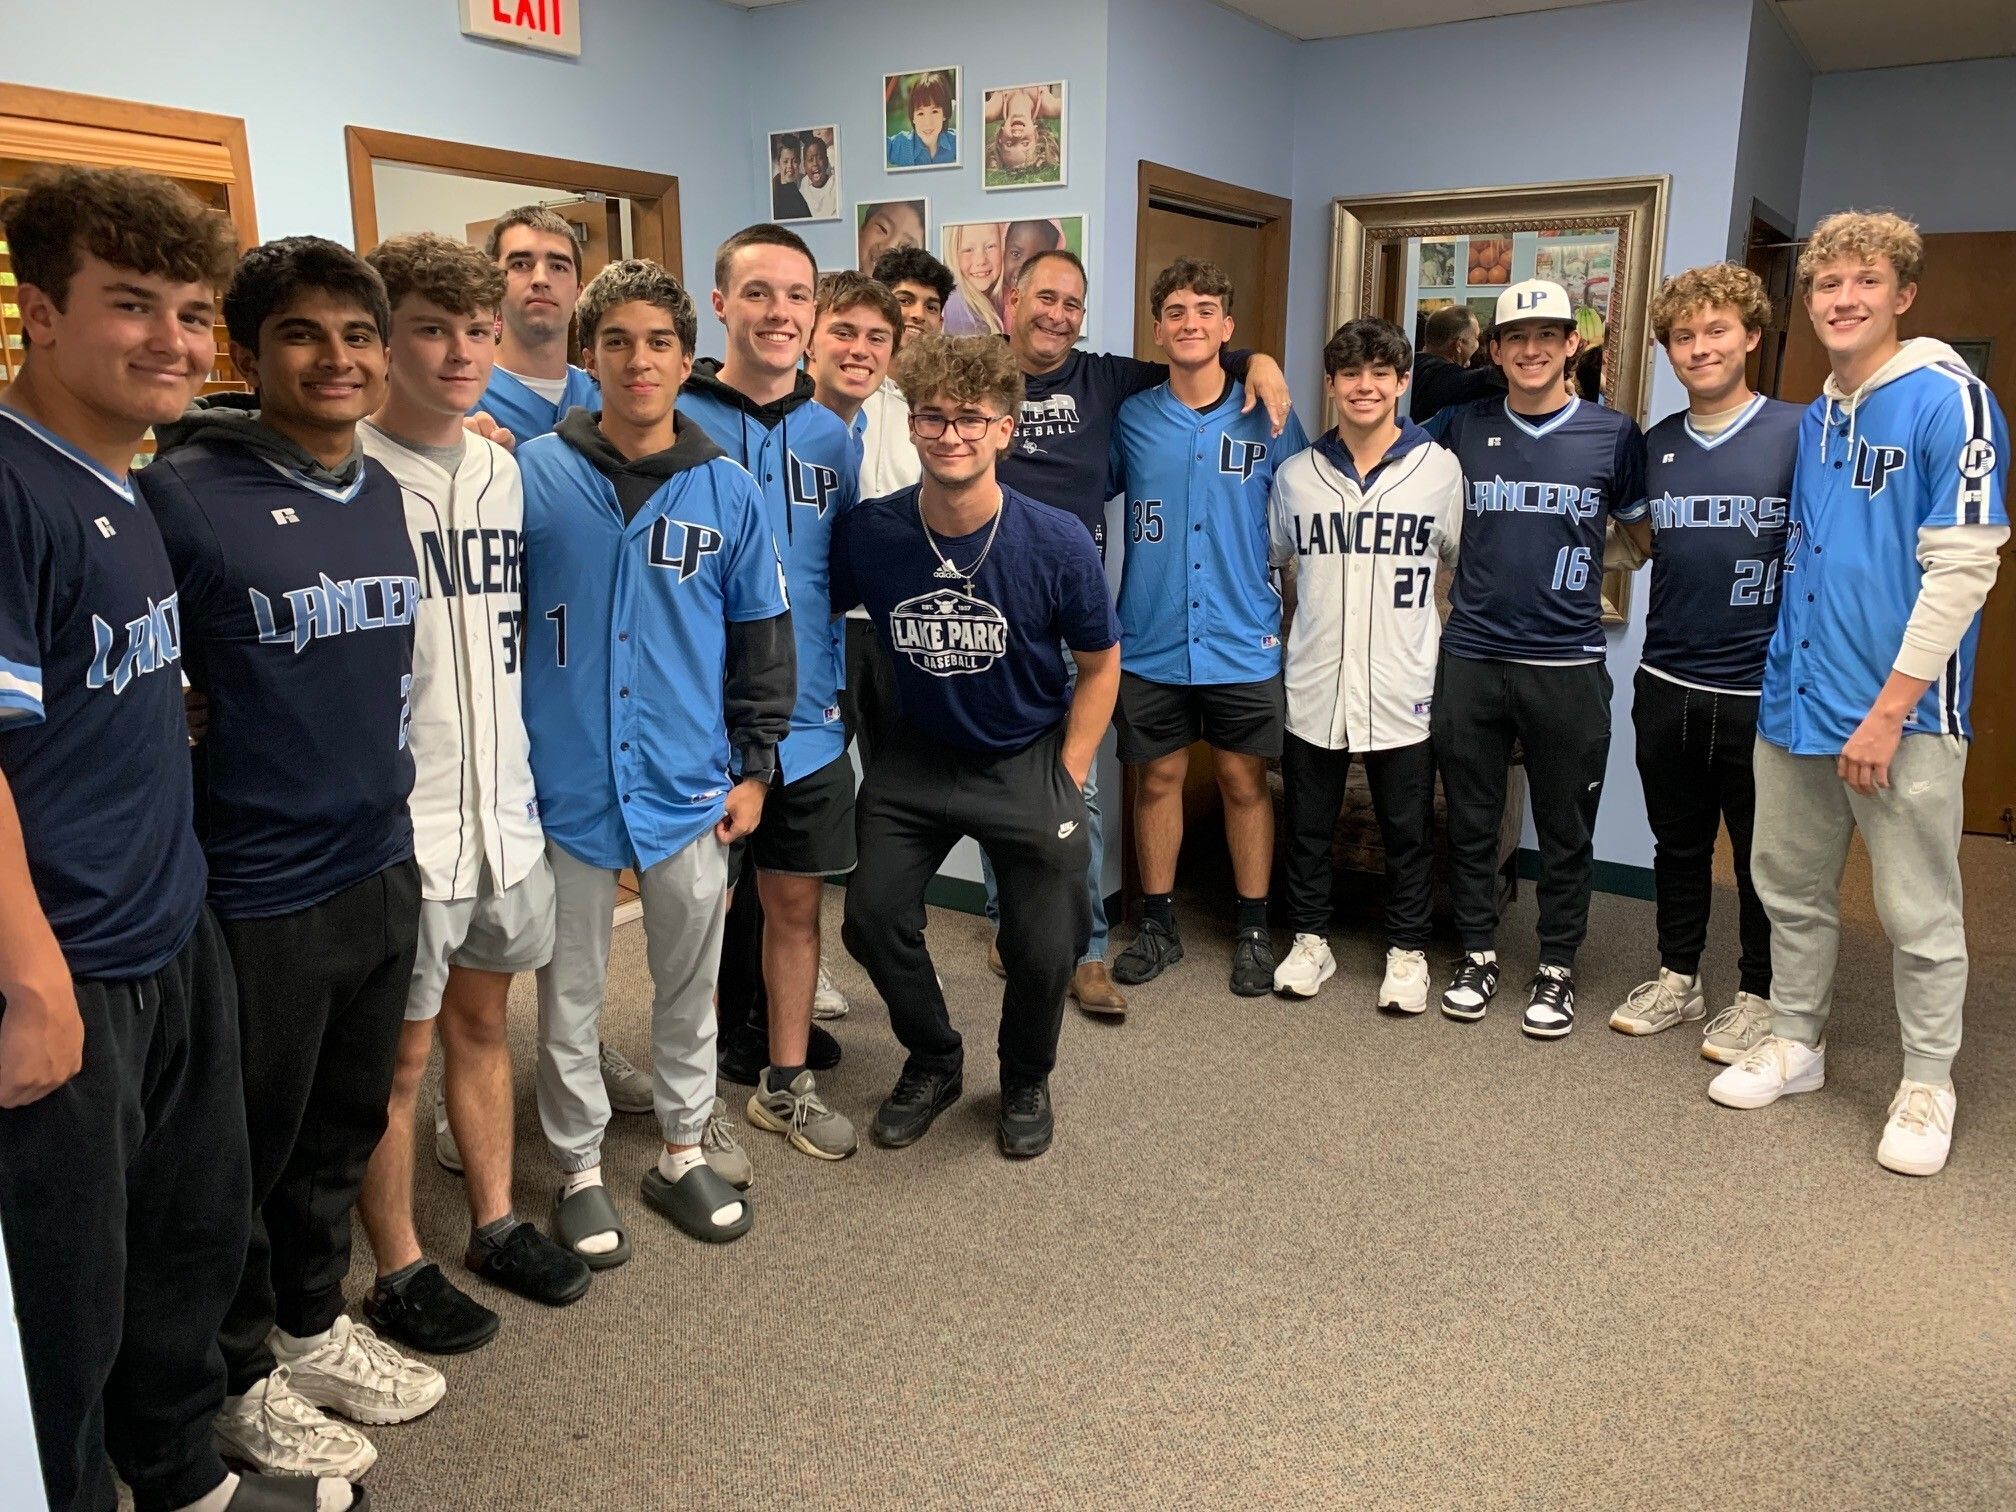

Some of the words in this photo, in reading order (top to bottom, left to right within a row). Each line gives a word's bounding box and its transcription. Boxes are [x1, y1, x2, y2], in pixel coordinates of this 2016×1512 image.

[1516, 291, 1548, 310] LP
[1219, 431, 1267, 485] LP
[1851, 435, 1907, 501] LP
[1965, 444, 1992, 470] LP
[788, 448, 839, 520] LP
[1463, 474, 1601, 526] LANCERS
[1132, 499, 1164, 543] 35
[1294, 511, 1435, 556] LANCERS
[1649, 491, 1786, 537] ANCERS
[418, 528, 523, 599] NCER
[648, 514, 724, 584] LP
[1551, 546, 1592, 591] 16
[1394, 567, 1432, 609] 27
[1730, 558, 1779, 606] 21
[545, 603, 568, 668] 1
[894, 619, 944, 650] LAKE
[947, 621, 1003, 652] PARK
[924, 655, 977, 669] BASEBALL
